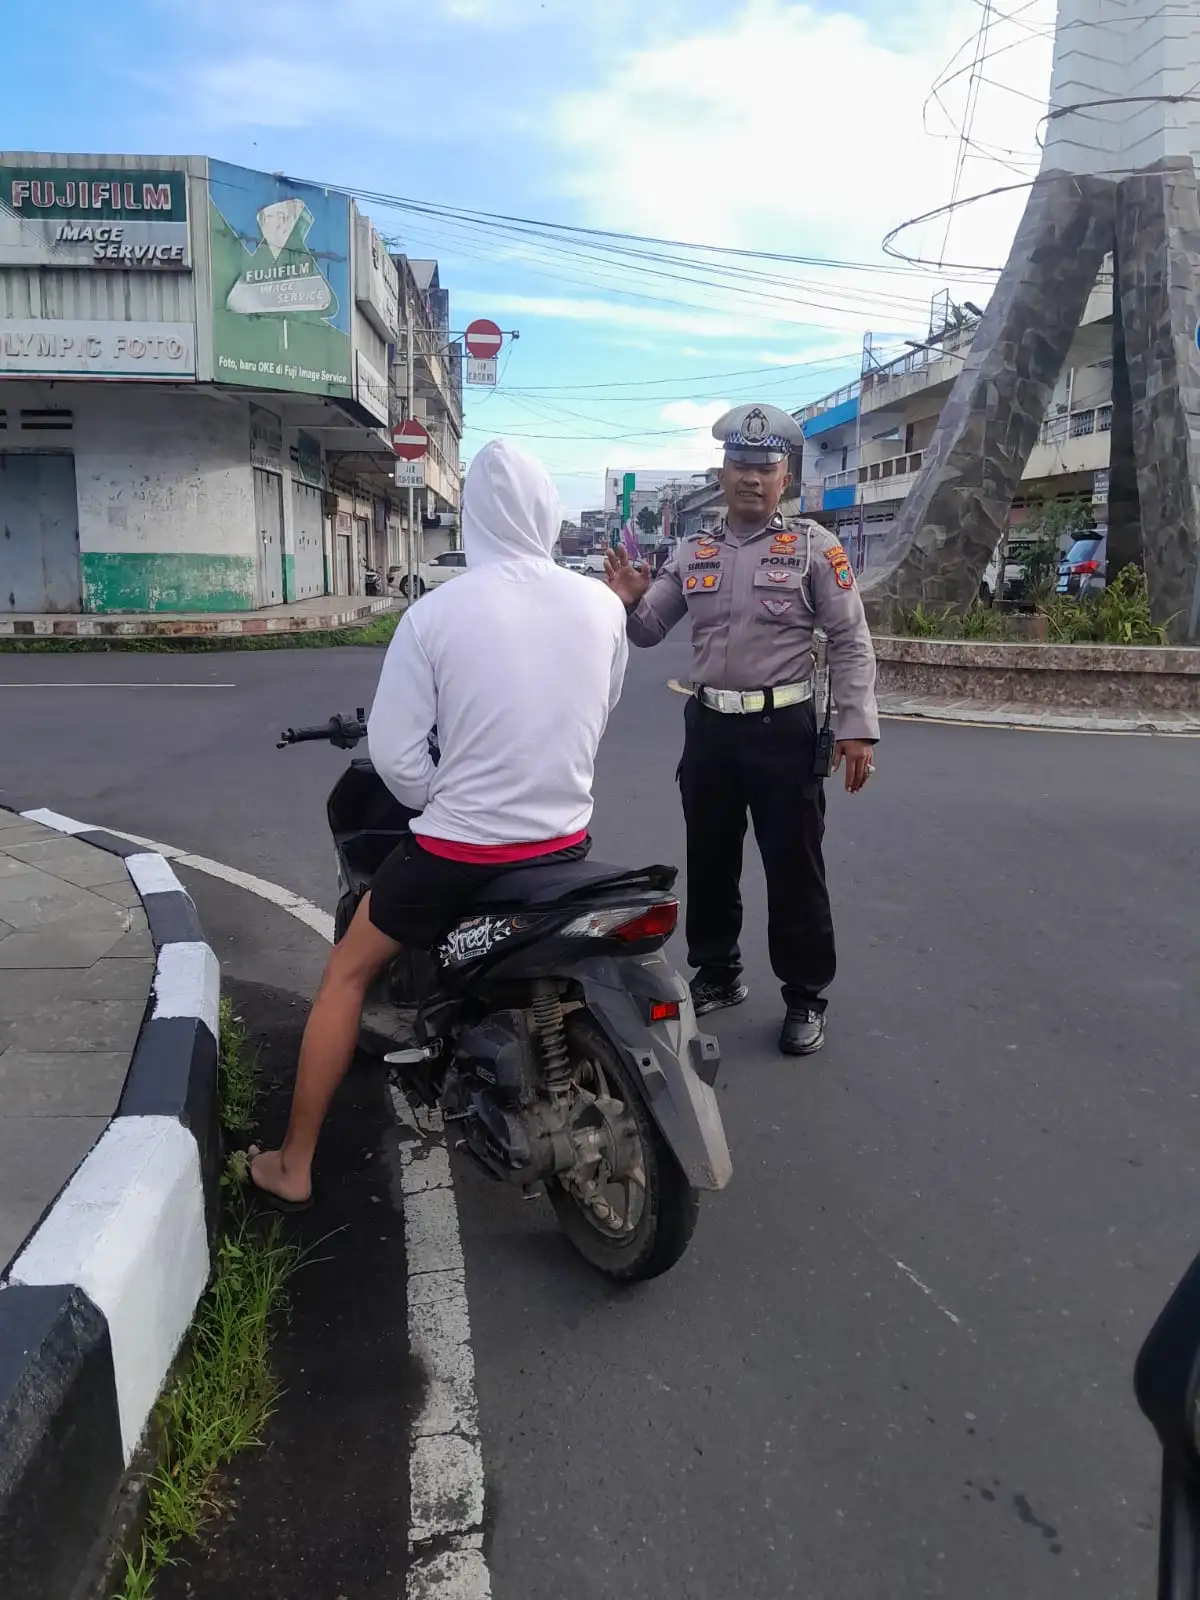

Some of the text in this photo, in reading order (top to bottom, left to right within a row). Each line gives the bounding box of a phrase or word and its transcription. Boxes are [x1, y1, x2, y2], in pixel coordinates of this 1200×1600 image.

[12, 180, 172, 210] FUJIFILM
[55, 226, 124, 242] IMAGE
[93, 242, 184, 260] SERVICE
[246, 262, 310, 282] FUJIFILM
[277, 290, 324, 304] SERVICE
[0, 333, 185, 359] LYMPIC FOTO
[218, 355, 347, 384] Foto, baru OKE di Fuji Image Service
[760, 557, 801, 567] POLRI
[446, 916, 493, 961] Street
